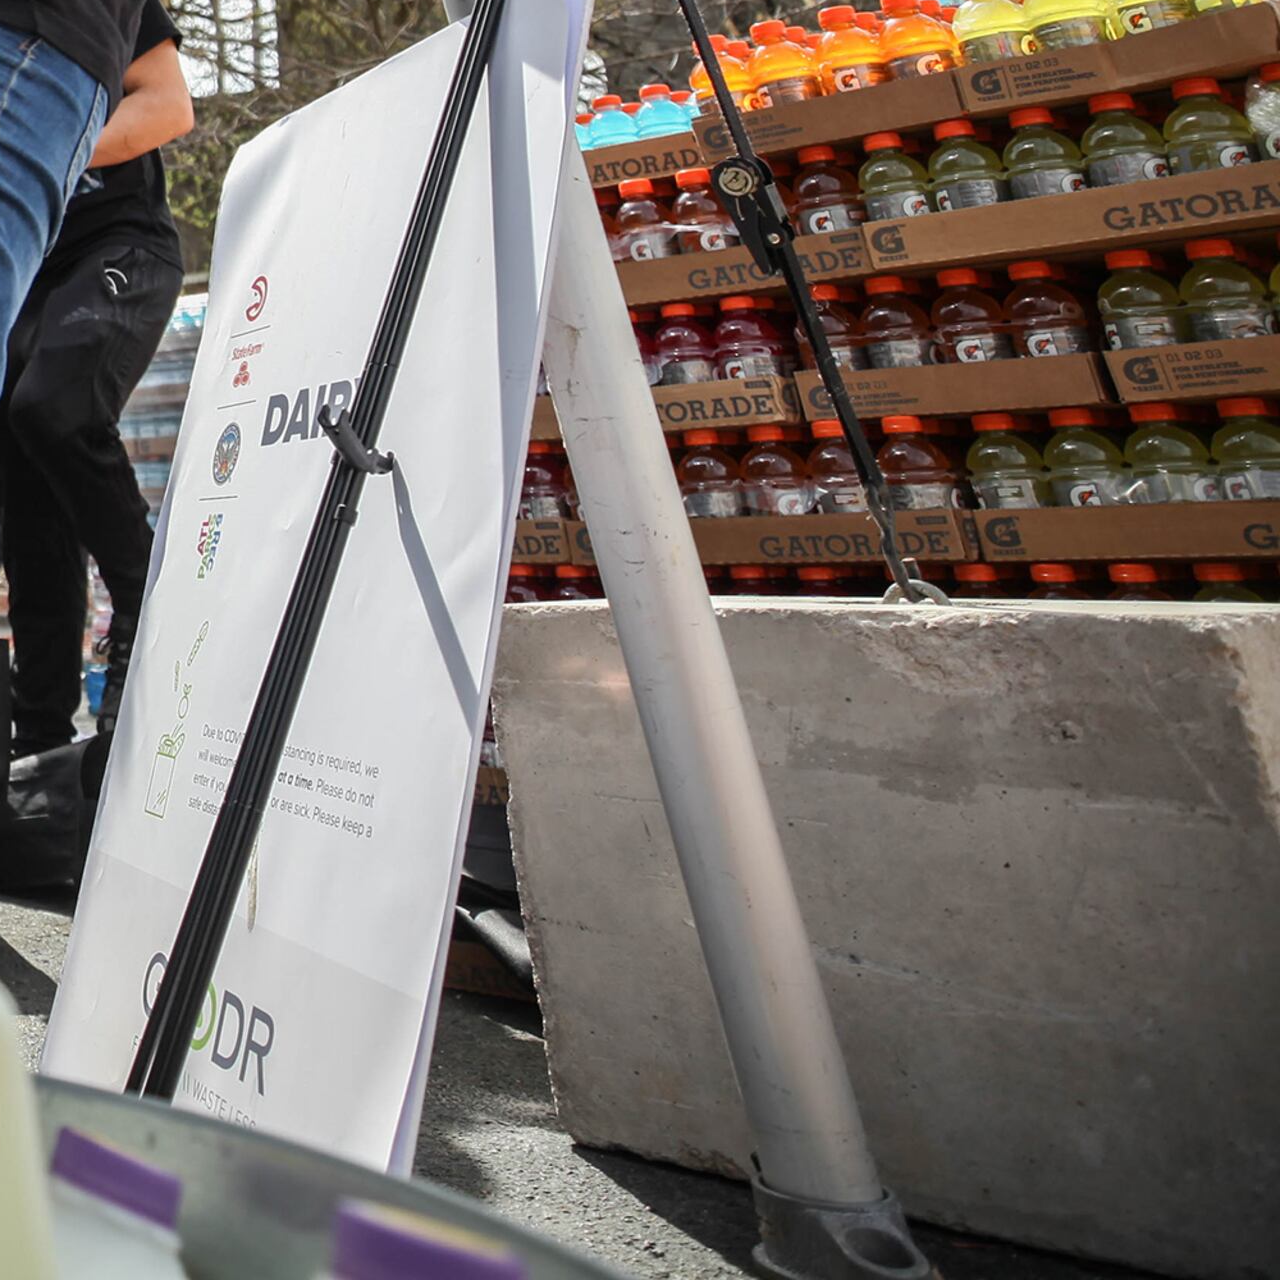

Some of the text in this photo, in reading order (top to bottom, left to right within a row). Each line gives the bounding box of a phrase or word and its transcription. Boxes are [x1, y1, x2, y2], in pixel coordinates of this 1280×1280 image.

[591, 149, 699, 184] ATORAD
[688, 245, 862, 291] GATOADE
[260, 376, 365, 448] DAIR
[656, 394, 773, 425] TORADE
[759, 528, 949, 558] GATORDE
[198, 749, 209, 763] will
[277, 770, 287, 784] at
[293, 773, 315, 792] time.
[315, 777, 344, 799] Please
[344, 786, 358, 803] do
[358, 792, 376, 809] not
[283, 744, 316, 766] stancing
[316, 750, 325, 766] is
[324, 753, 363, 777] required,
[365, 762, 380, 779] we
[188, 795, 221, 817] safe dista
[193, 772, 208, 788] enter
[270, 796, 279, 808] or
[279, 798, 293, 814] are
[294, 800, 312, 820] sick.
[312, 806, 340, 829] Please
[341, 813, 365, 837] keep
[365, 824, 373, 839] a
[192, 1077, 228, 1121] WASTE
